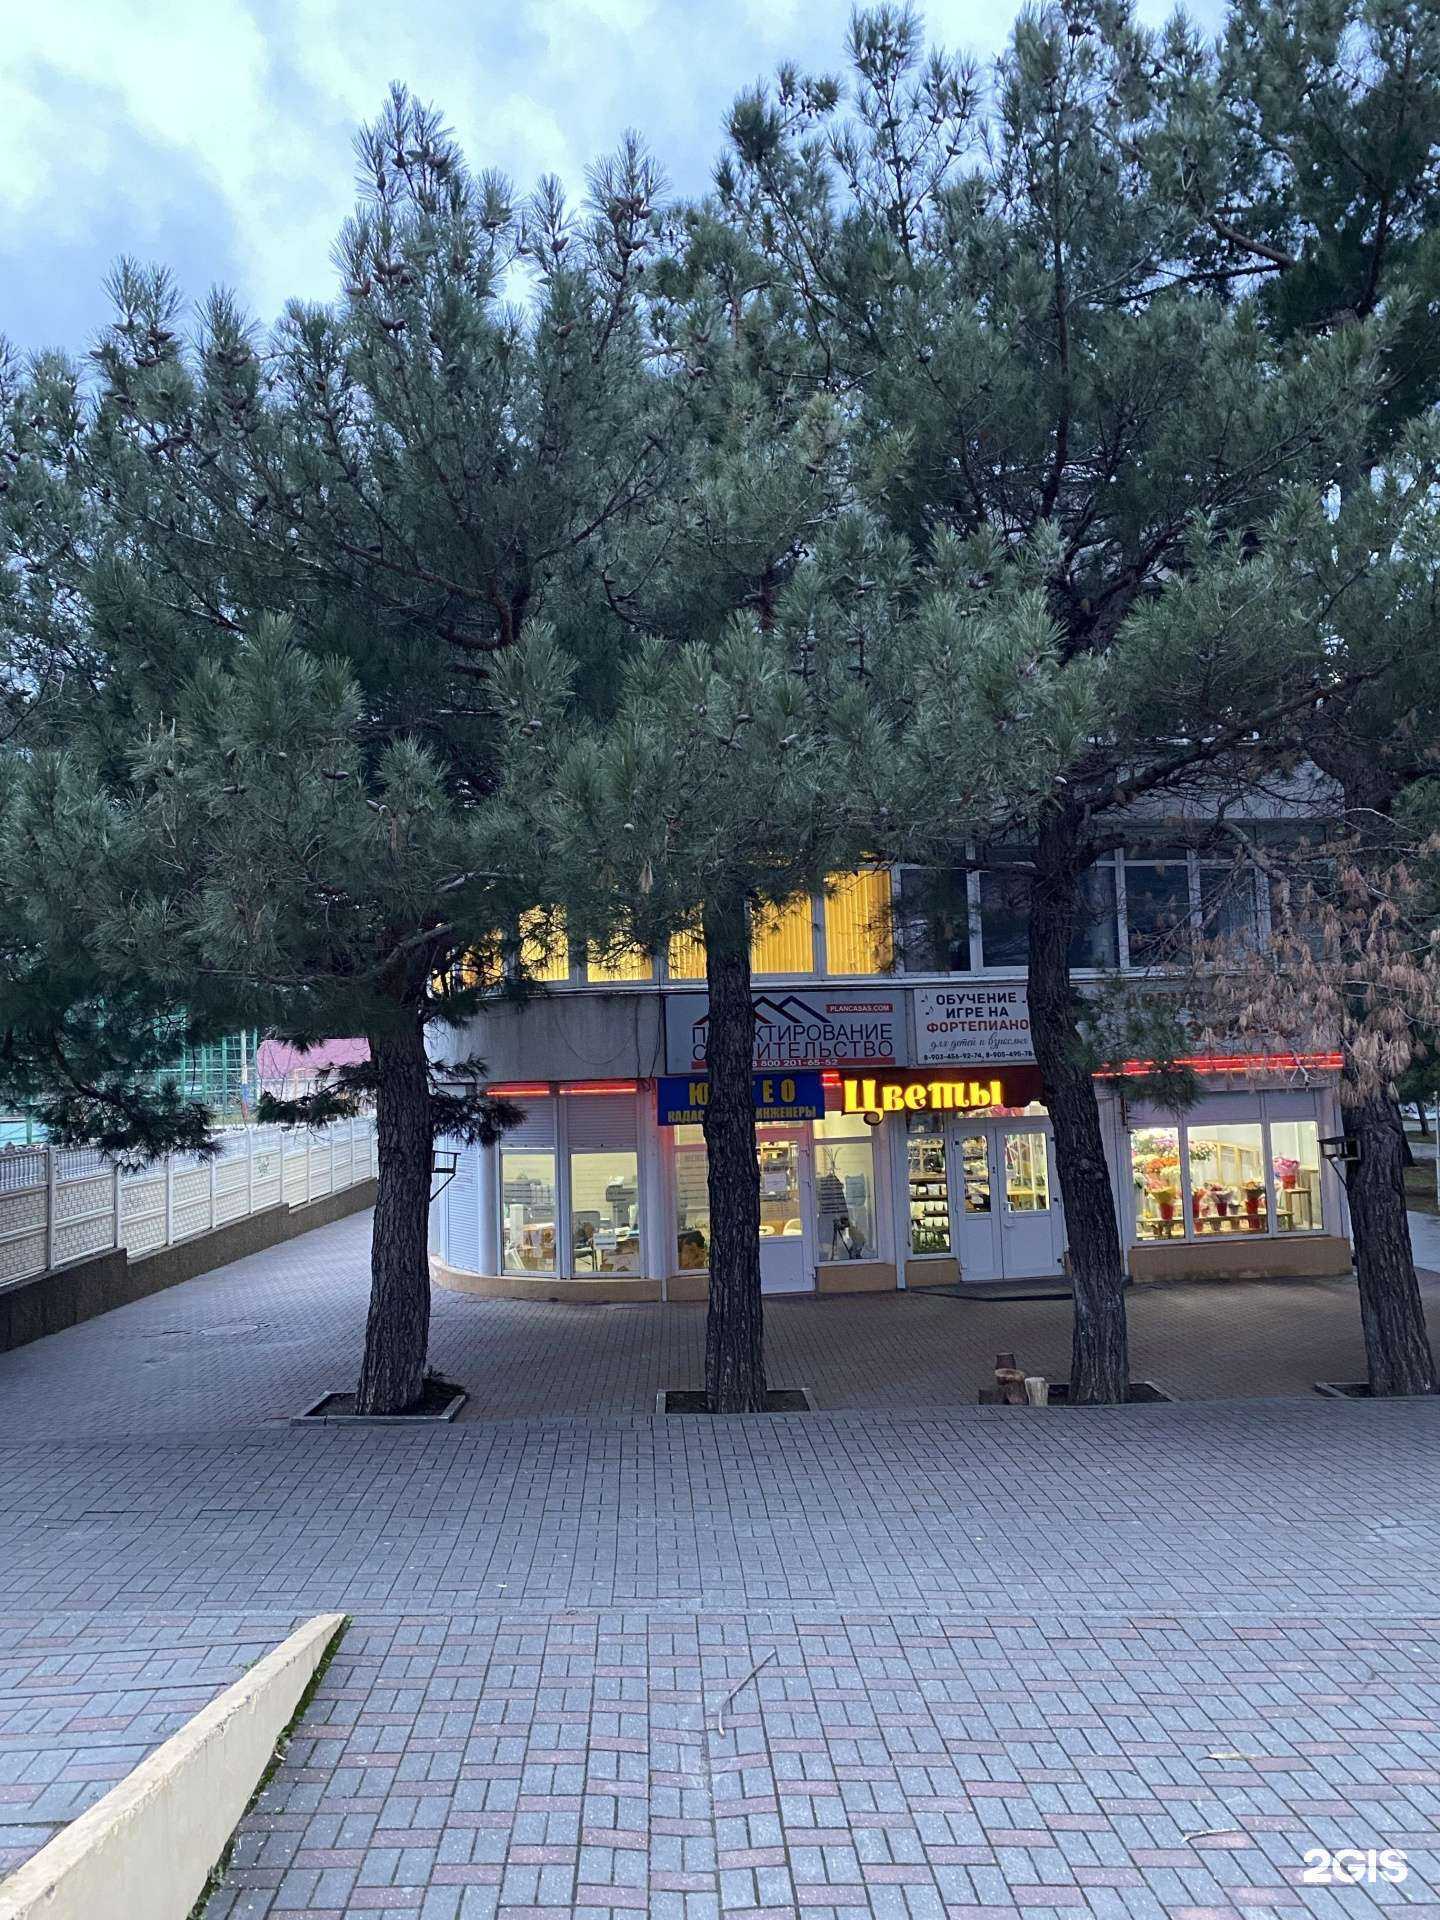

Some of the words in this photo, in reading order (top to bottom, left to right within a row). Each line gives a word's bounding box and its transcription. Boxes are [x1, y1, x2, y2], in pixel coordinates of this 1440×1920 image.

[936, 992, 1017, 1006] ОБУЧЕНИЕ
[829, 1004, 890, 1012] PLANCASAS.COM
[946, 1007, 984, 1019] ИГРЕ
[988, 1006, 1009, 1018] НА
[692, 1023, 893, 1043] ПКТИРОВАНИЕ
[927, 1019, 1029, 1034] ФОРТЕПИАНО
[692, 1040, 894, 1060] СИТЕЛЬСТВО
[950, 1037, 976, 1052] детей
[784, 1059, 838, 1067] 201-65-52
[843, 1080, 1003, 1125] Цветы
[755, 1106, 816, 1120] ИНЖЕНЕРЫ
